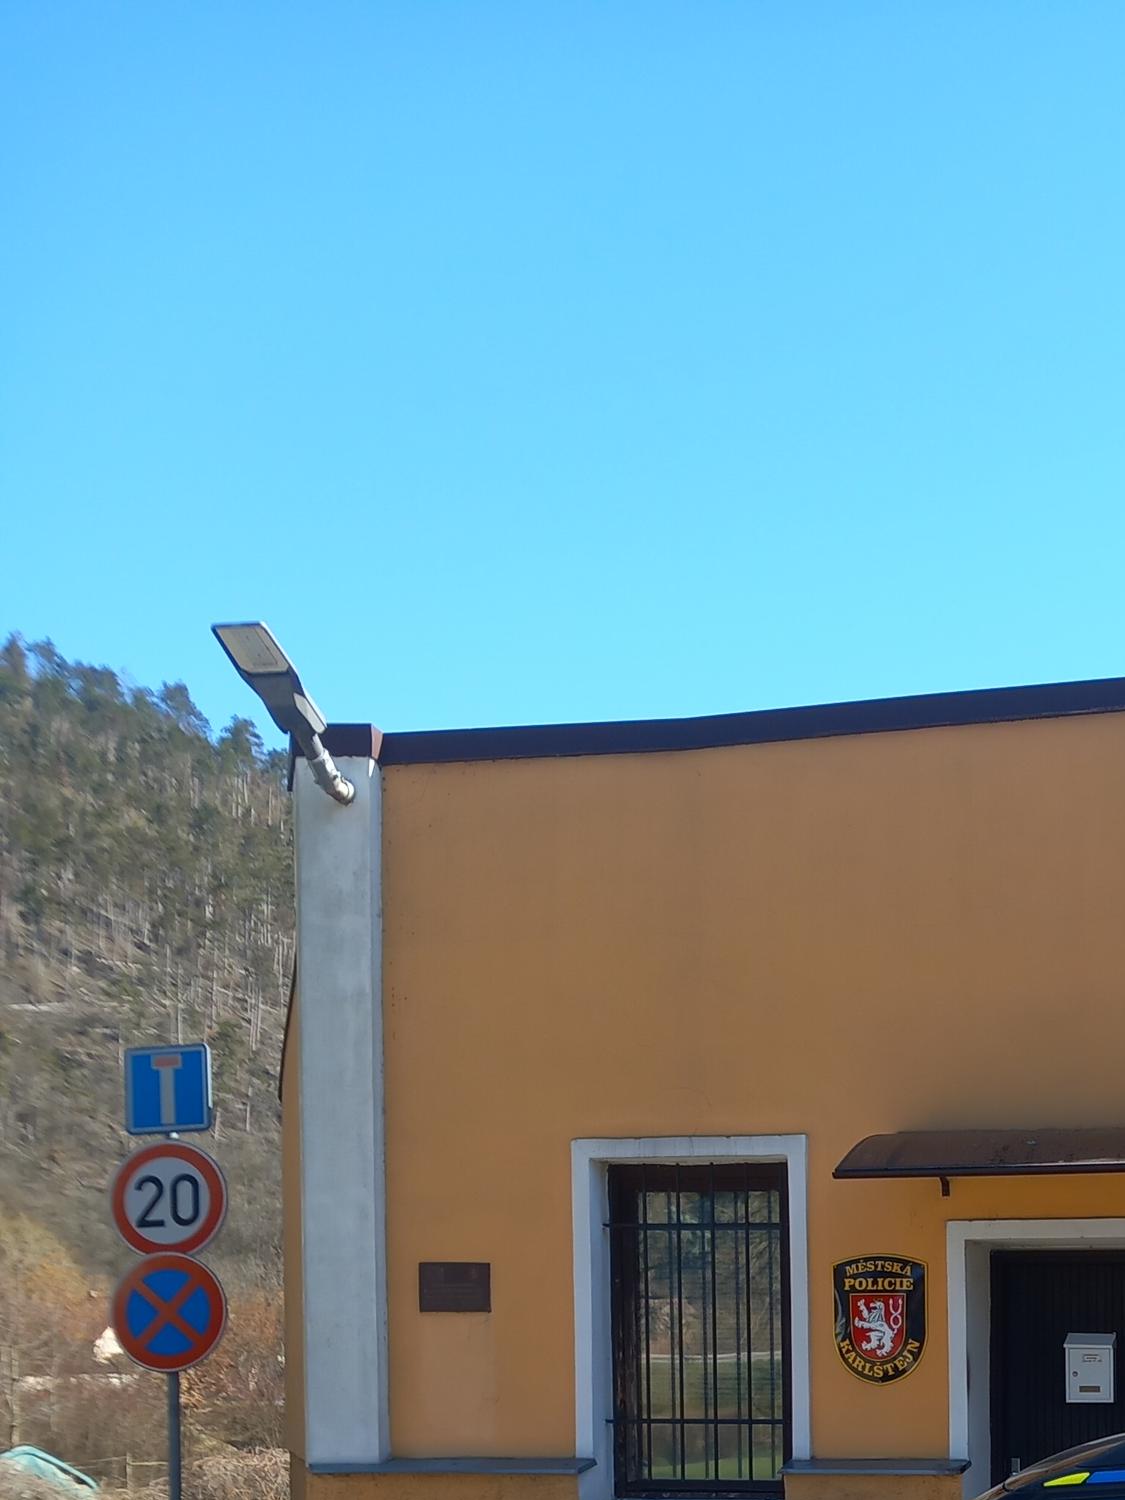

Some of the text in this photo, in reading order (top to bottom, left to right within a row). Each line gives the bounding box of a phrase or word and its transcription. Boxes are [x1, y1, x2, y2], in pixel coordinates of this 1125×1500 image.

[134, 1174, 200, 1228] 20
[845, 1260, 912, 1276] MĚSTSKÁ
[844, 1278, 914, 1290] POLICIE
[840, 1338, 920, 1378] KARLŠTEJN
